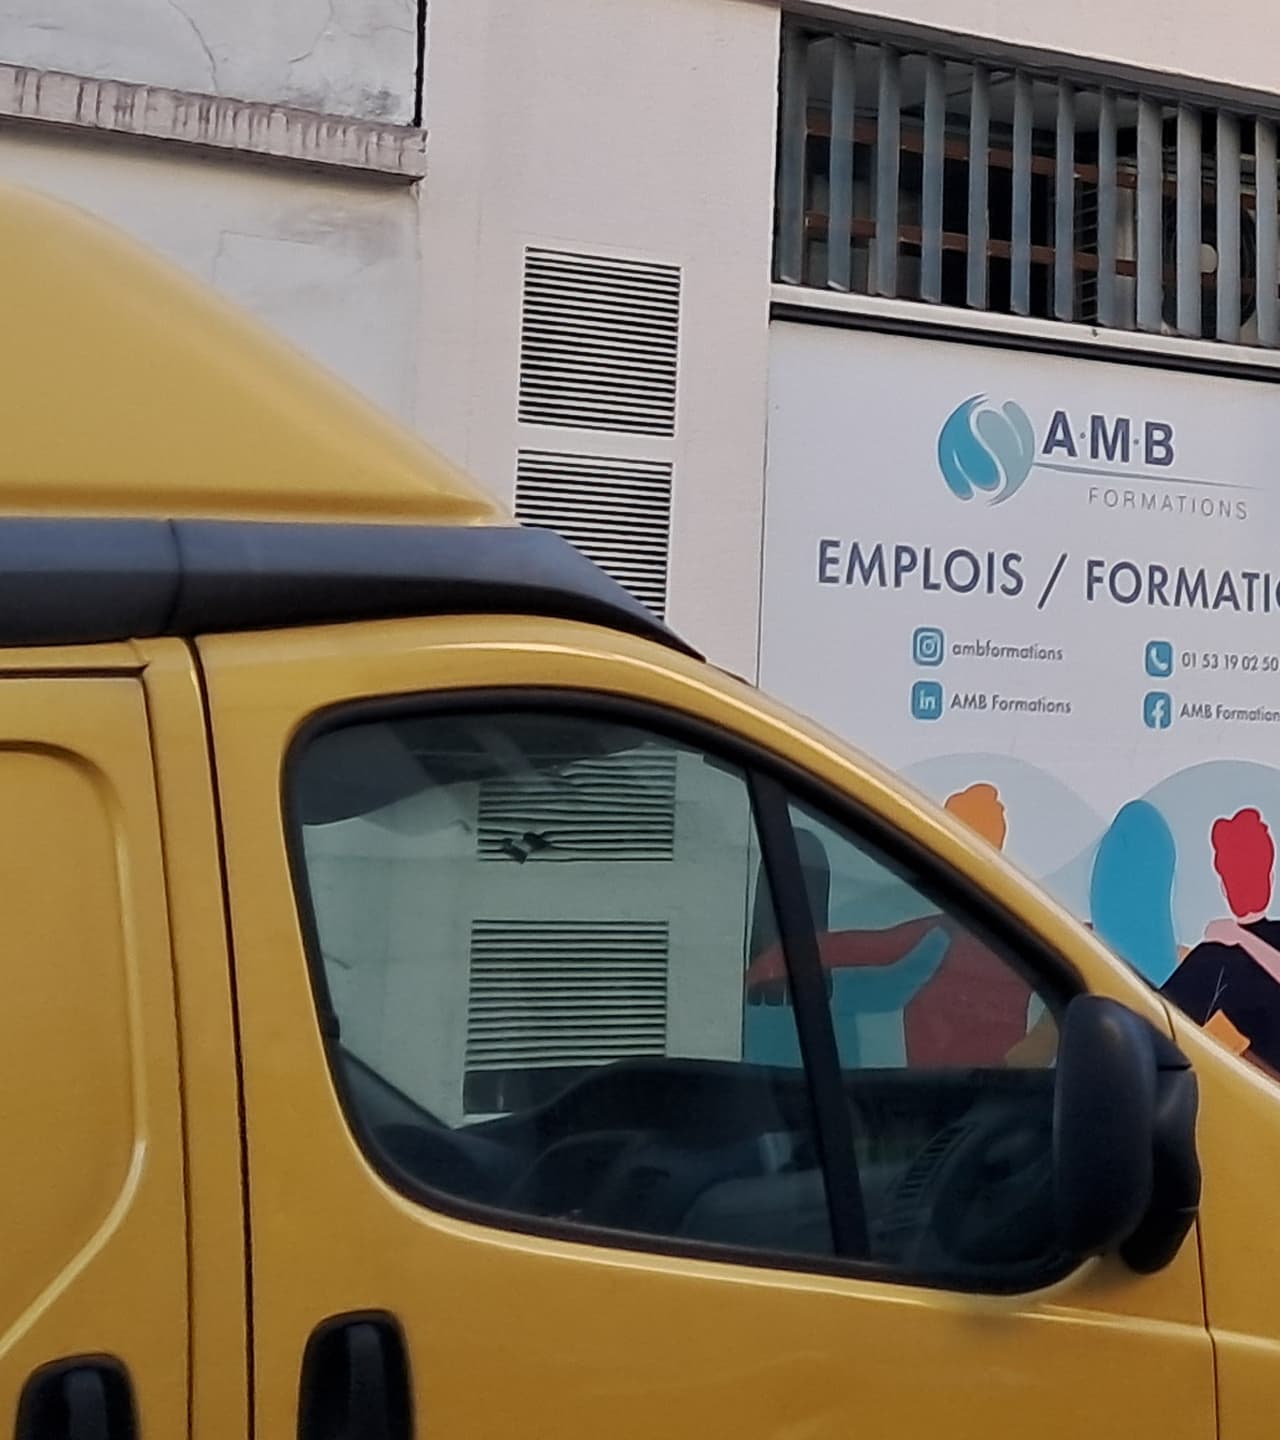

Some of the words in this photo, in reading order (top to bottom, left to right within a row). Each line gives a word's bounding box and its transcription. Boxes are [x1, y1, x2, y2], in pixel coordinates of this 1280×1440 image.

[1087, 486, 1250, 521] FORMATIONS
[817, 538, 1024, 597] EMPLOIS
[951, 639, 1064, 662] ambformations
[1181, 653, 1197, 668] 01
[1201, 653, 1219, 670] 53
[1223, 654, 1239, 671] 19
[1241, 654, 1259, 672] 02
[1261, 656, 1280, 673] 50
[949, 693, 988, 711] AMB
[991, 694, 1072, 715] Formations
[1179, 703, 1213, 720] AMB
